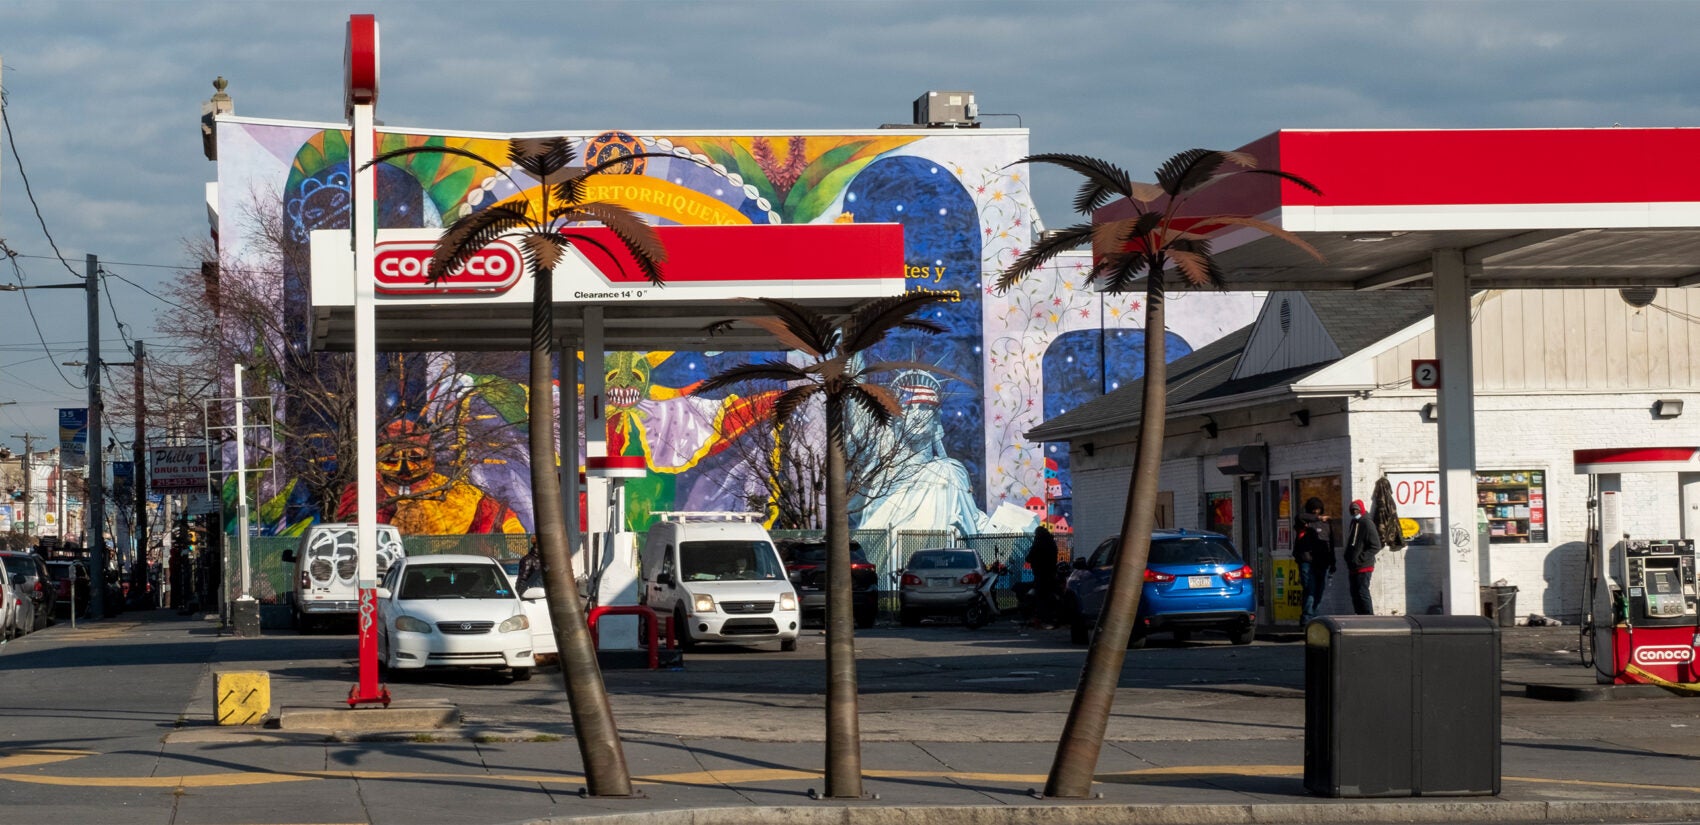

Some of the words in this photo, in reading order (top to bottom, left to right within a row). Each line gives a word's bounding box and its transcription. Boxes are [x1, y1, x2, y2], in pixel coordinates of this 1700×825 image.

[586, 185, 739, 225] ERTORRIQUEÑ
[904, 264, 930, 278] tes
[934, 266, 946, 283] y
[574, 291, 619, 299] Clearance
[904, 285, 961, 302] ultura
[1422, 368, 1431, 381] 2
[155, 450, 193, 465] Philly
[1396, 480, 1441, 506] OPE
[1287, 589, 1302, 606] HER
[1640, 650, 1690, 660] conoco
